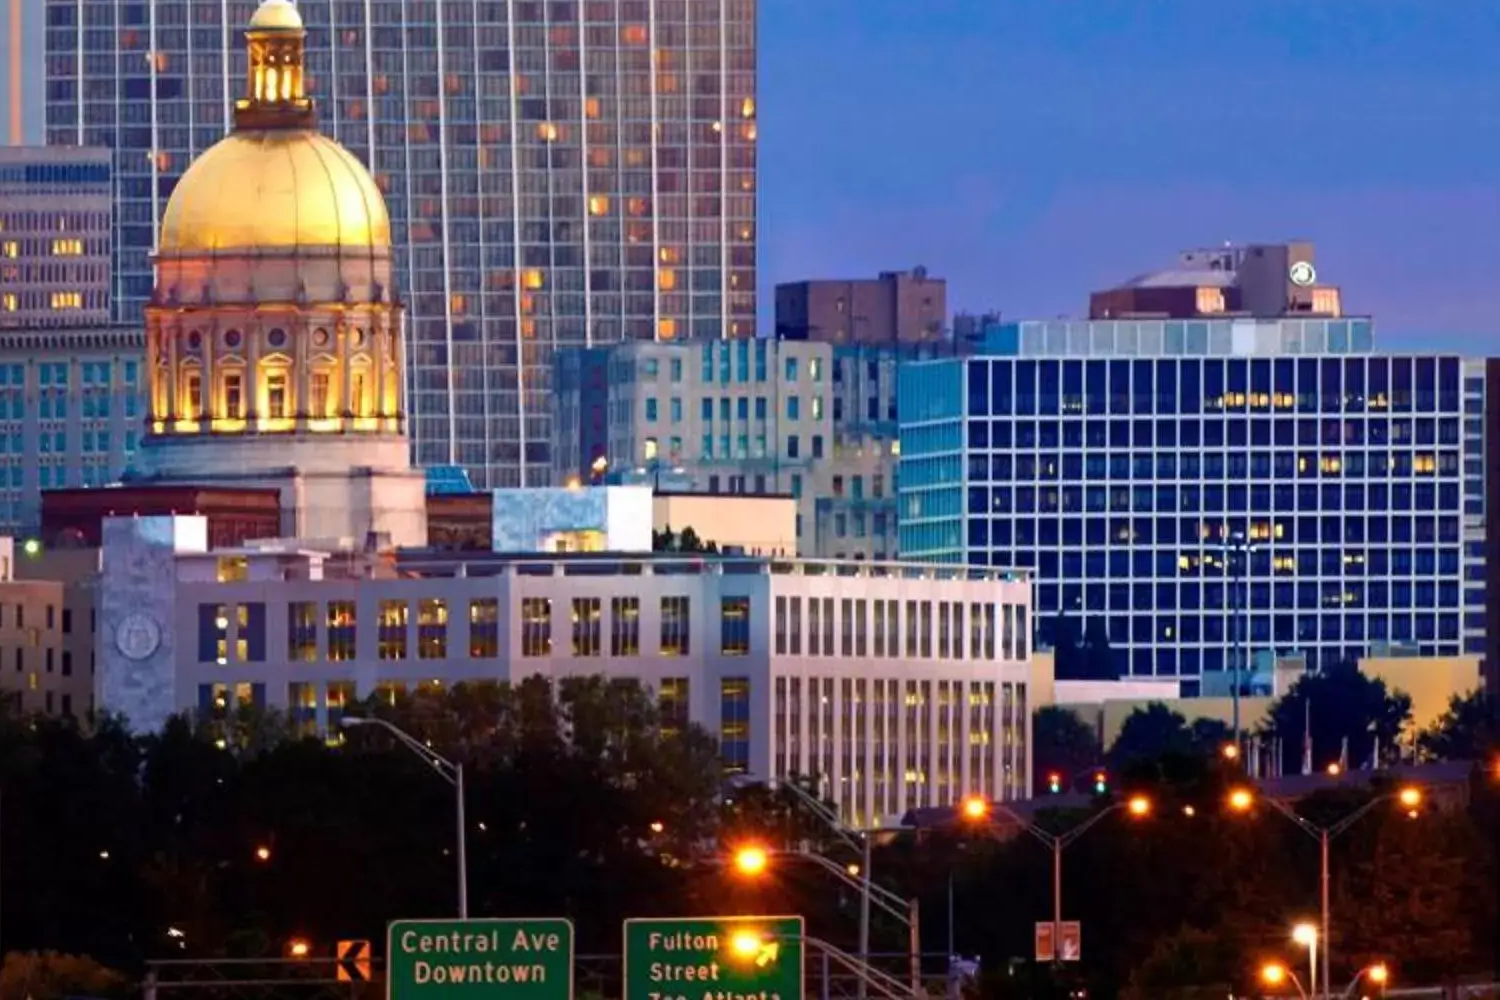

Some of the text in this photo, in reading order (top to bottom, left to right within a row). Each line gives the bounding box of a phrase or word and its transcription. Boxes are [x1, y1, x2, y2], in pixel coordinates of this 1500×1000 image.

[401, 929, 560, 953] Central Ave
[649, 931, 719, 950] Fulton
[414, 961, 546, 984] Downtown
[650, 961, 720, 981] Street
